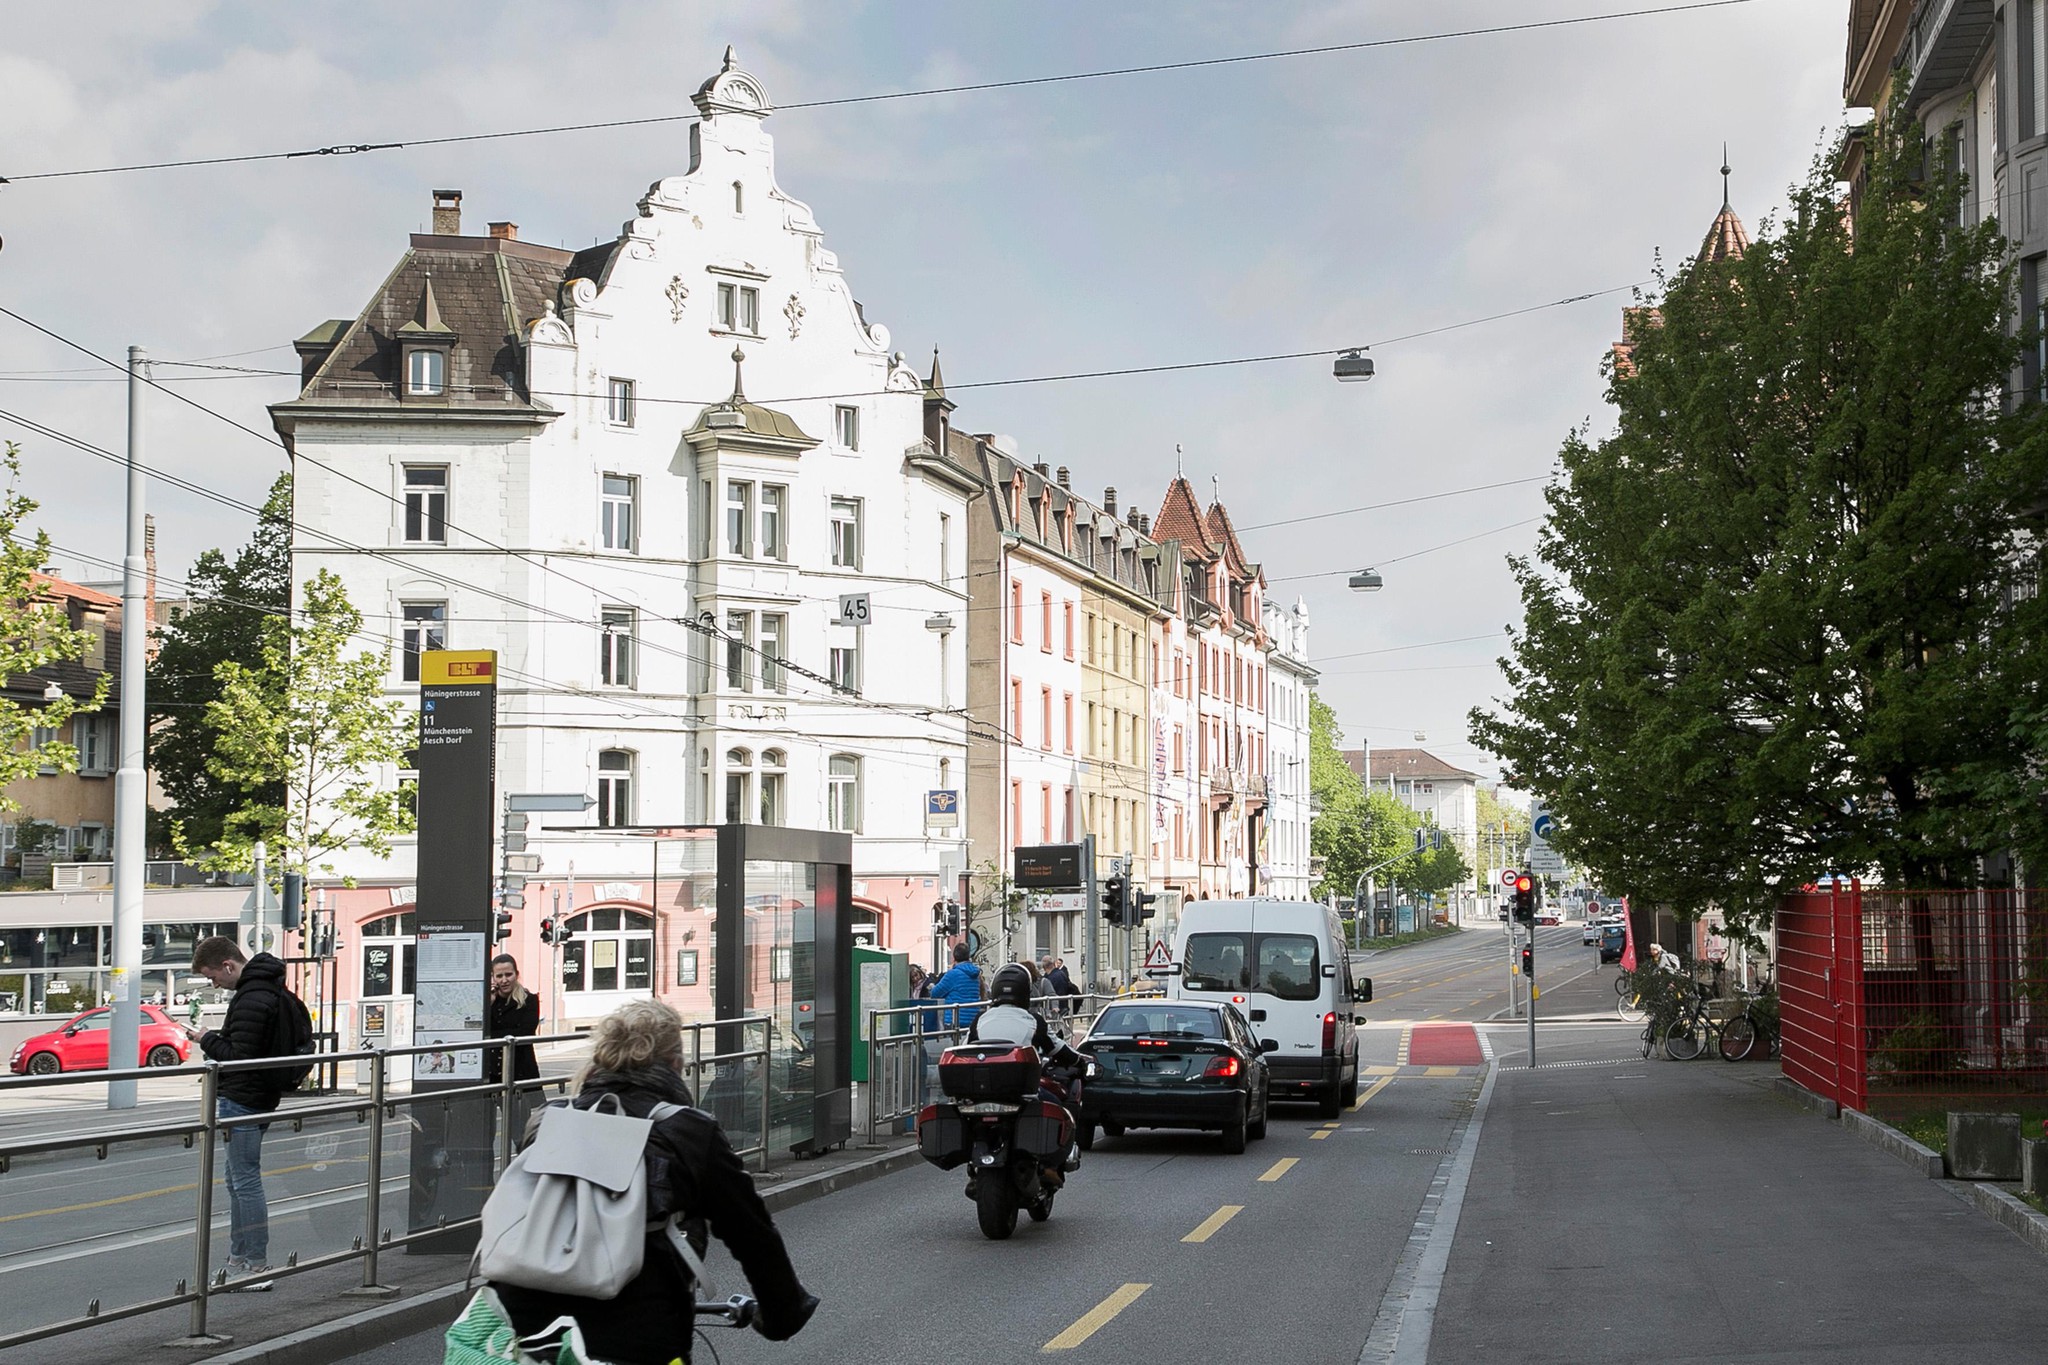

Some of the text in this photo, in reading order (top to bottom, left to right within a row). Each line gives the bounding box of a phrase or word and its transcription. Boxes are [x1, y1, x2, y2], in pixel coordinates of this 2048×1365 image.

[844, 599, 867, 620] 45
[450, 663, 480, 675] BLT
[424, 689, 481, 698] Hüningerstrasse
[423, 715, 435, 726] 11
[423, 727, 473, 735] Münchenstein
[423, 736, 462, 745] Aesch Dorf
[1114, 861, 1120, 871] S
[420, 924, 464, 932] Hüningerstrasse
[369, 949, 388, 958] Take
